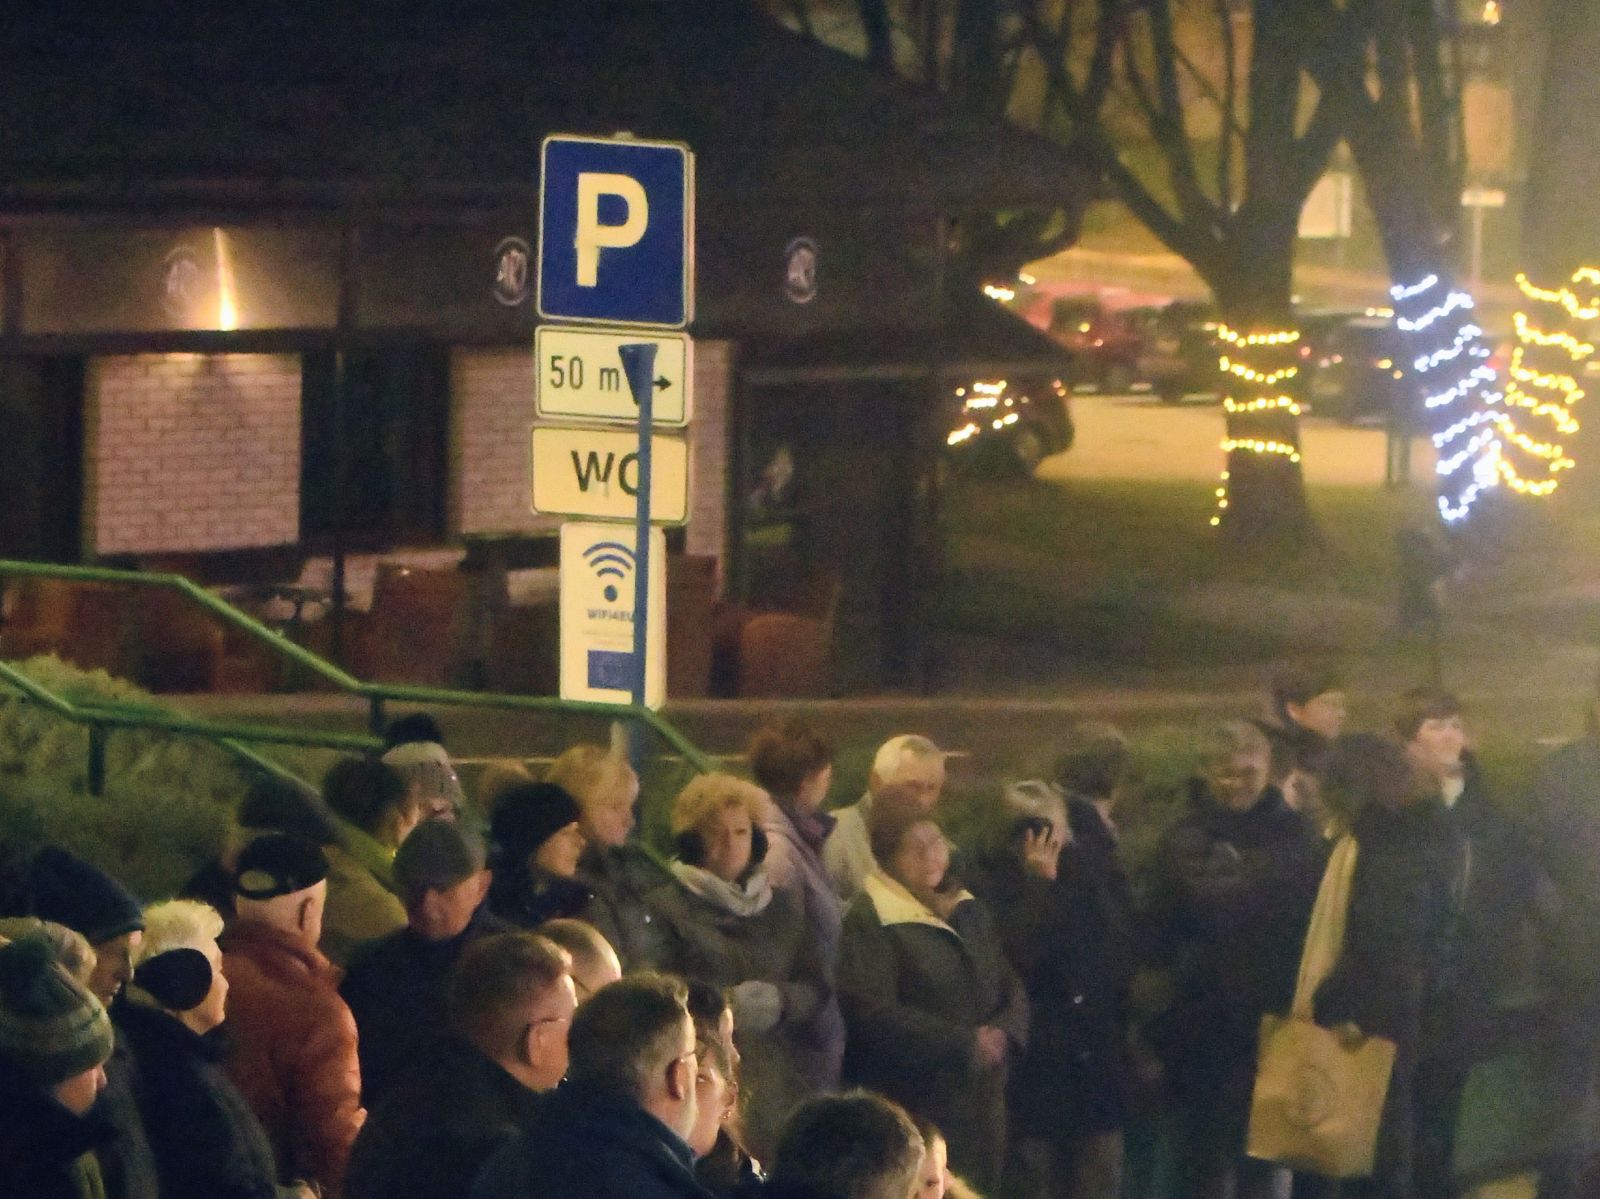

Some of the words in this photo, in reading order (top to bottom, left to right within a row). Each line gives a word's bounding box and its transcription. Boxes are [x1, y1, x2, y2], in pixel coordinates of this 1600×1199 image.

[575, 171, 649, 288] P
[550, 354, 584, 390] 50
[599, 366, 620, 392] m
